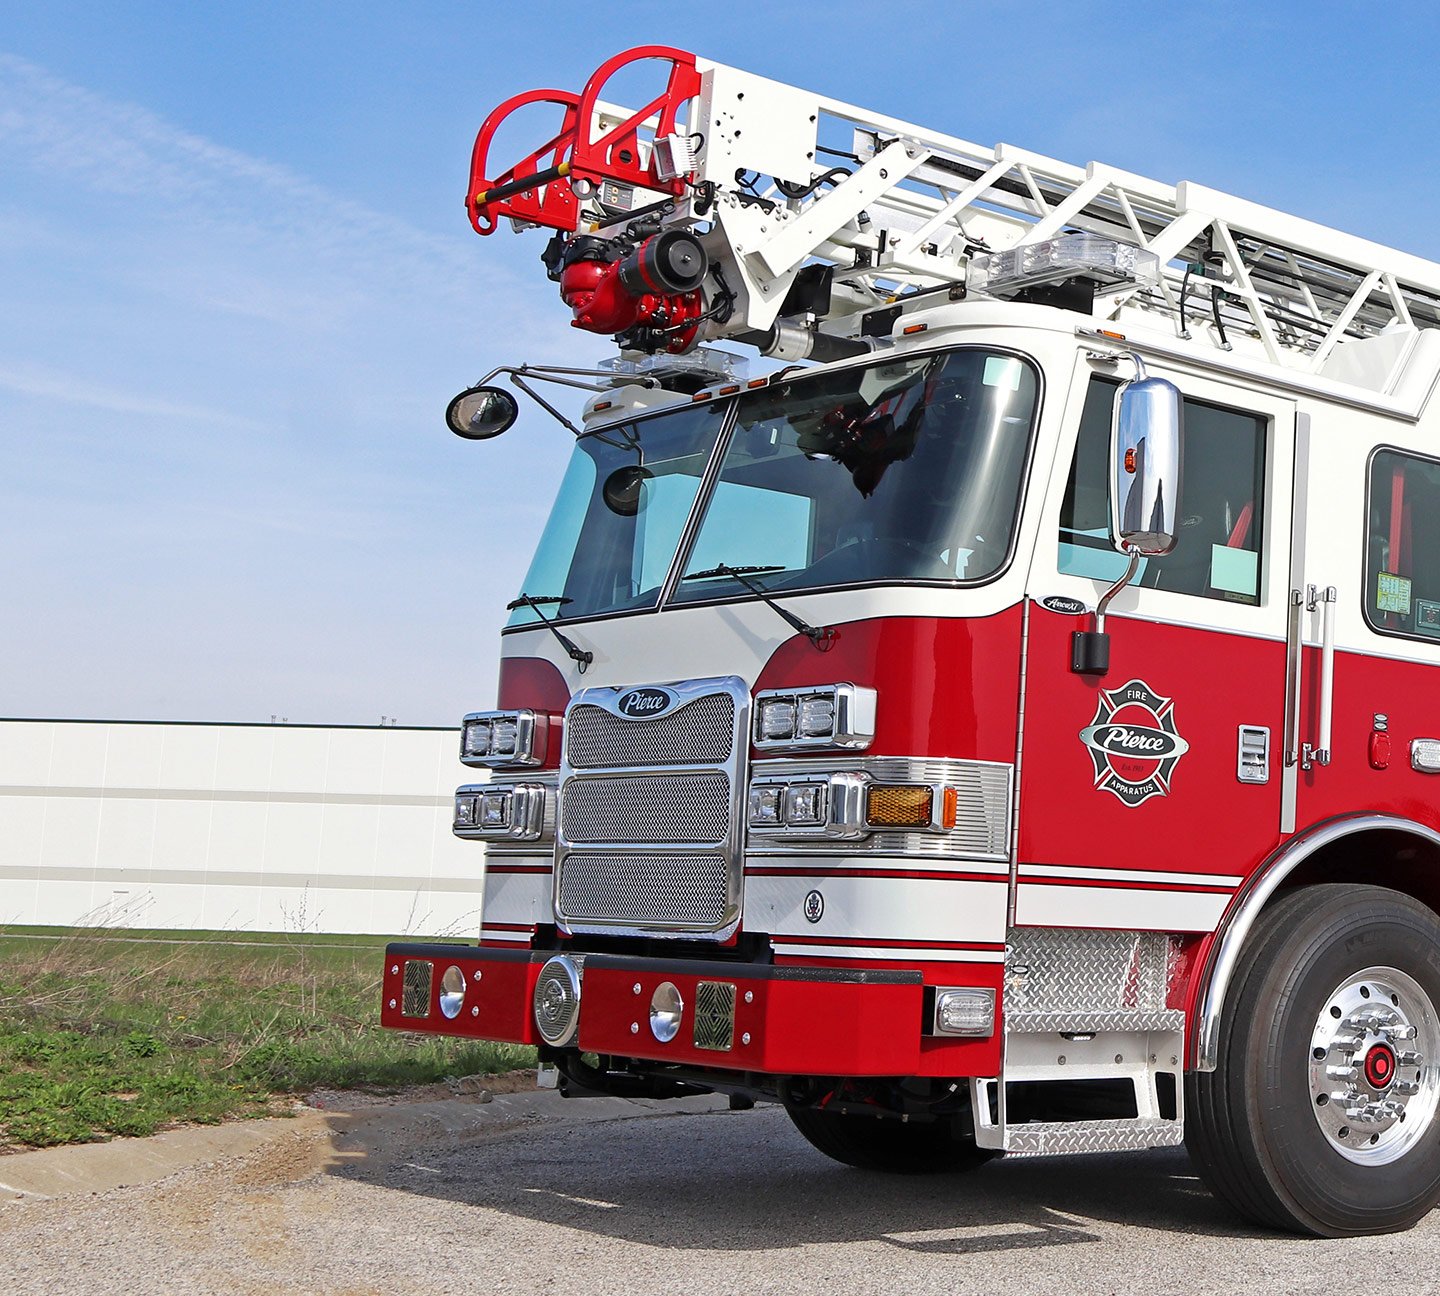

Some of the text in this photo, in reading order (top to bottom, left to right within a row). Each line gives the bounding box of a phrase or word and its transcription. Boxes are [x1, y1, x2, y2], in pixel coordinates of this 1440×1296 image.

[624, 691, 664, 714] Pierce
[1127, 690, 1148, 701] FIRE
[1103, 727, 1165, 751] Pierce
[1111, 780, 1154, 795] APPARATUS
